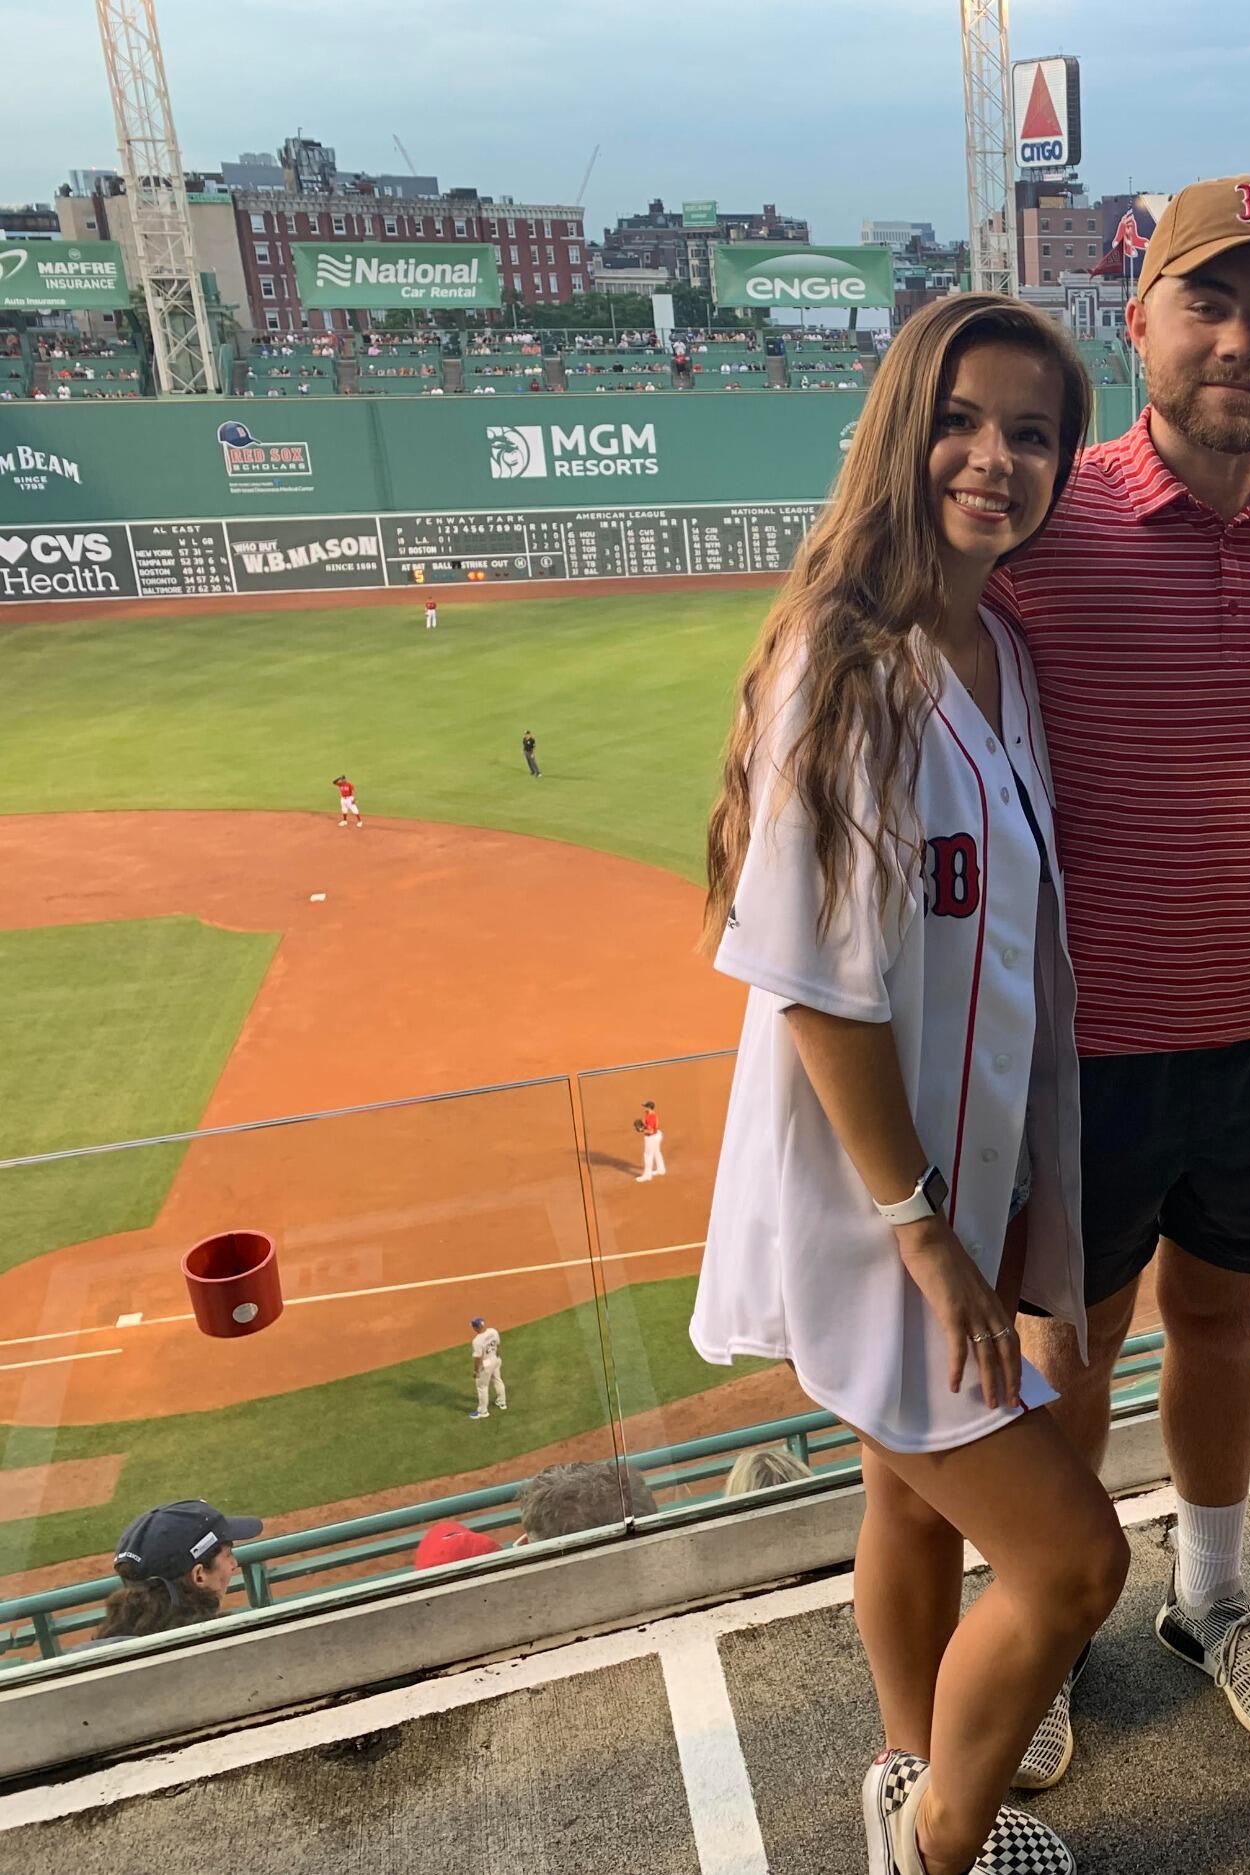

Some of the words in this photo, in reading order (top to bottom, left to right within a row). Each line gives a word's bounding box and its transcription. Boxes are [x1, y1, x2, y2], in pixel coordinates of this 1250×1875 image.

[1021, 140, 1062, 162] CITGO
[37, 262, 117, 274] MAPFRE
[355, 258, 478, 283] National
[46, 279, 115, 289] INSURANCE
[401, 286, 425, 298] Car
[430, 286, 476, 298] Rental
[4, 297, 26, 305] Auto
[550, 423, 656, 456] MGM
[230, 448, 265, 463] RED
[270, 447, 304, 462] SOX
[16, 445, 82, 485] BEAM
[233, 463, 306, 471] SCHOLARS
[554, 459, 659, 477] RESORTS
[576, 512, 625, 520] AMERICAN
[629, 510, 666, 518] LEAGUE
[171, 525, 200, 534] EAST
[30, 533, 112, 564] CVS
[233, 543, 256, 553] WHO
[258, 541, 278, 552] BUT
[408, 546, 437, 555] BOSTON
[325, 563, 354, 572] SINCE
[490, 560, 509, 568] OUT
[139, 568, 170, 576] BOSTON
[0, 564, 120, 595] Health
